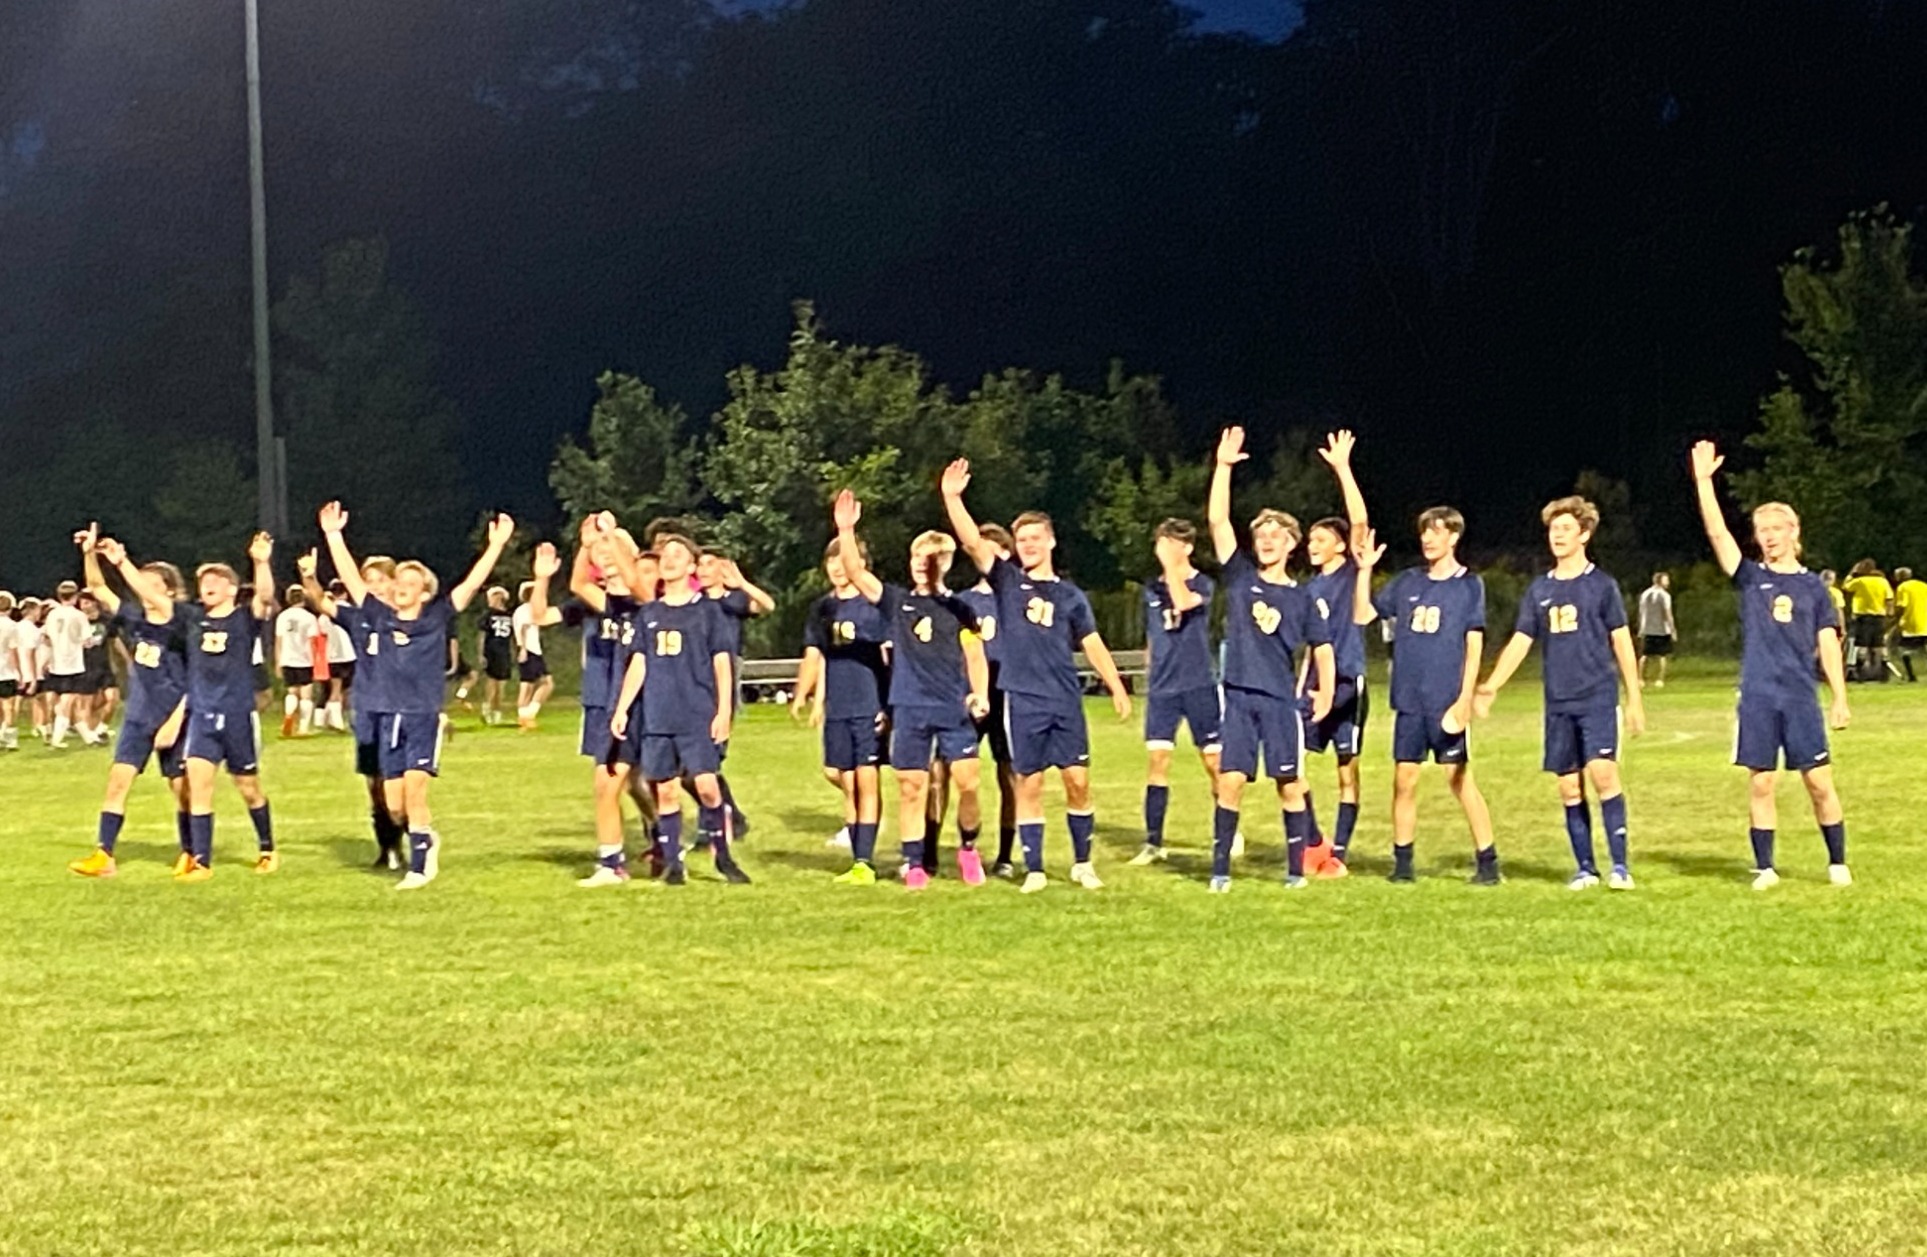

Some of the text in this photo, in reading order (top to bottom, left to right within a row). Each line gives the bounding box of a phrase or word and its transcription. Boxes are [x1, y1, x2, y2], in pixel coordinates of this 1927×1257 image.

[1026, 596, 1054, 627] 31
[1548, 604, 1578, 633] 12
[1772, 595, 1793, 623] 2
[656, 630, 682, 656] 19
[914, 616, 933, 642] 4
